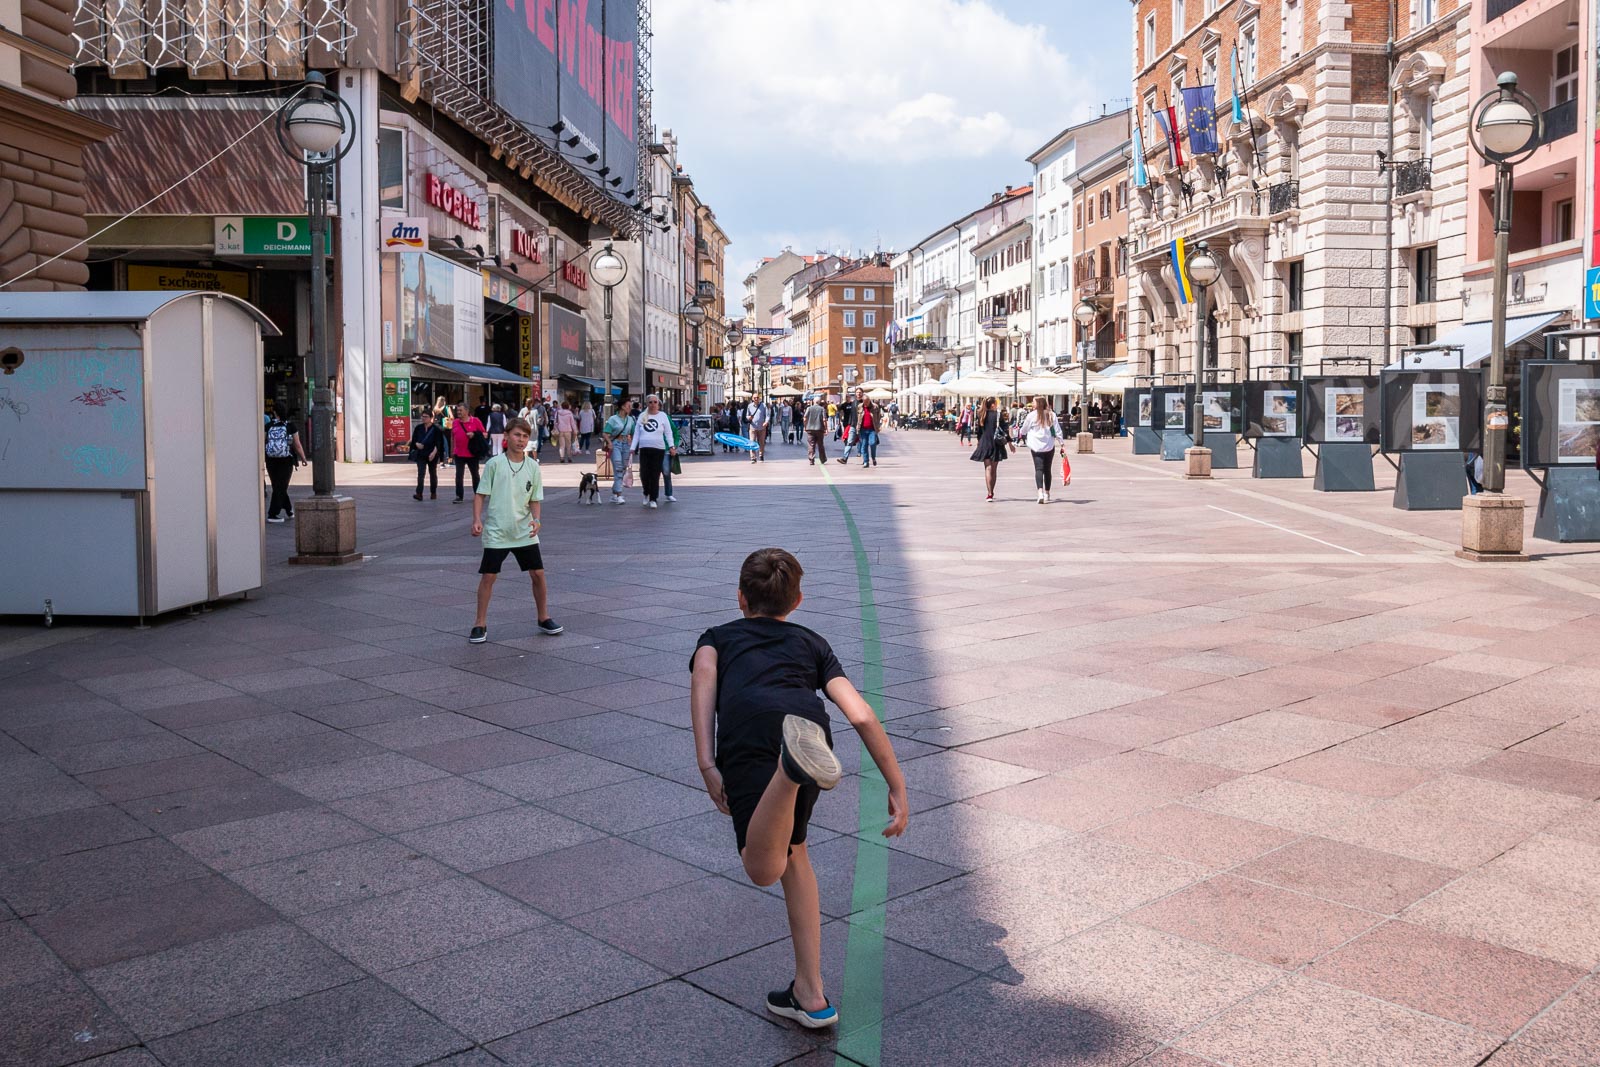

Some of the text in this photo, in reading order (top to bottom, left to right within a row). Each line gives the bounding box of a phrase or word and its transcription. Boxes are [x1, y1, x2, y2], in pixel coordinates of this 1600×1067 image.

[426, 173, 481, 231] ROBNA
[277, 222, 297, 242] D
[391, 222, 420, 239] dm
[185, 270, 218, 280] Money
[521, 318, 530, 359] OTKUP
[390, 405, 404, 413] Grill
